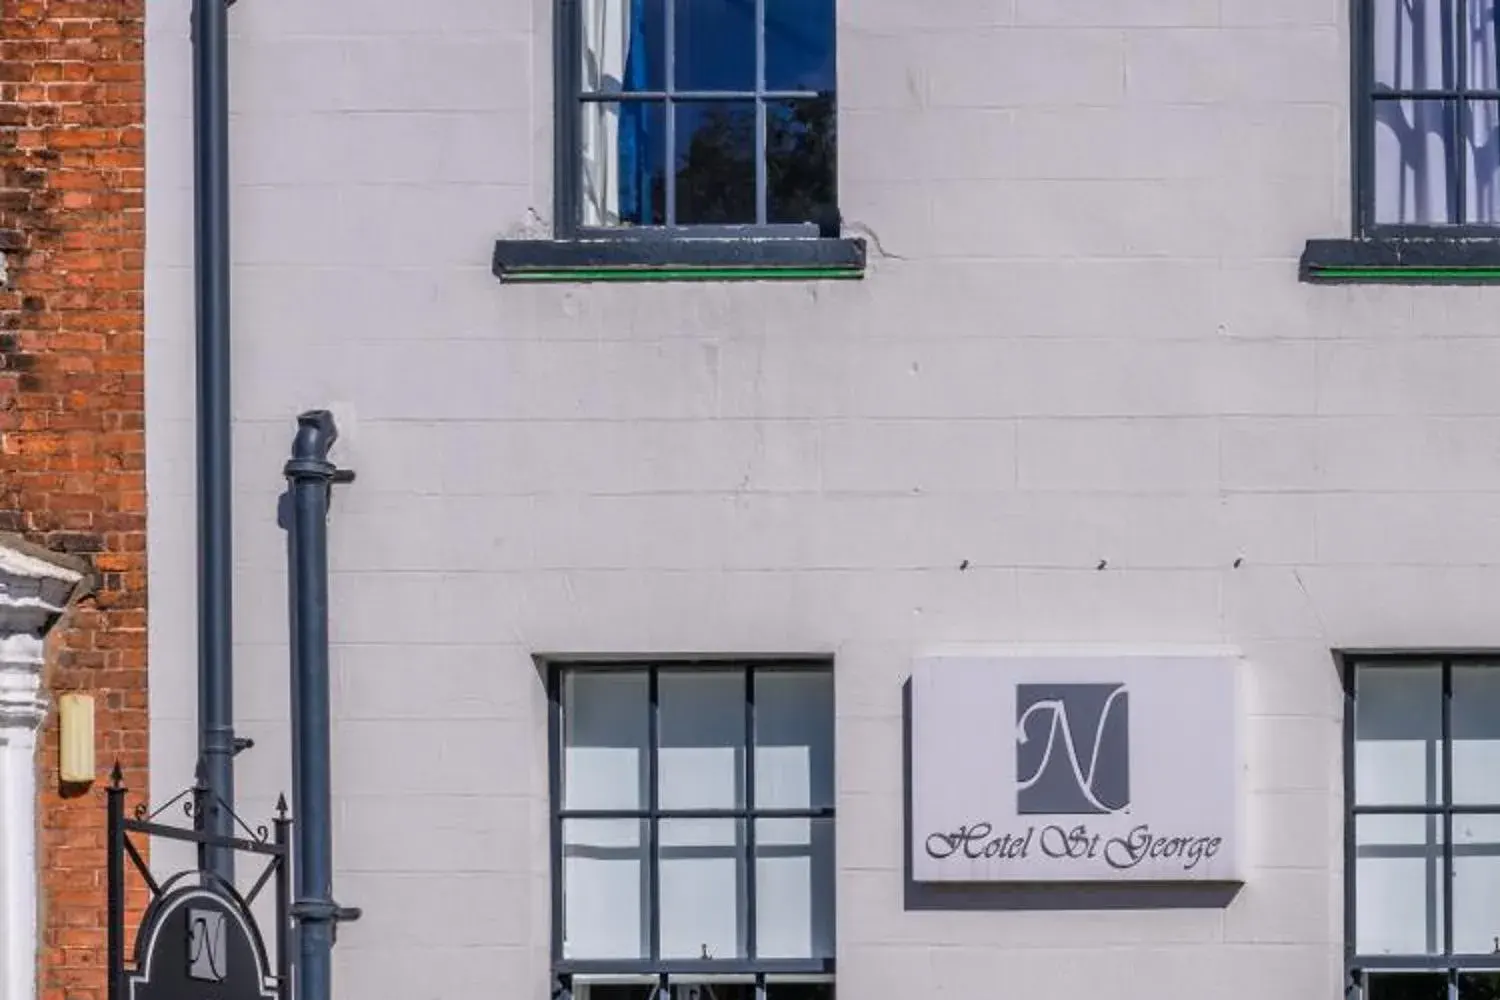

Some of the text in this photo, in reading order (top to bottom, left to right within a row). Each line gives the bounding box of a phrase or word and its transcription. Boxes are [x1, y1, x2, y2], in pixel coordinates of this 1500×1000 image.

[925, 822, 1222, 870] Hotel St George
